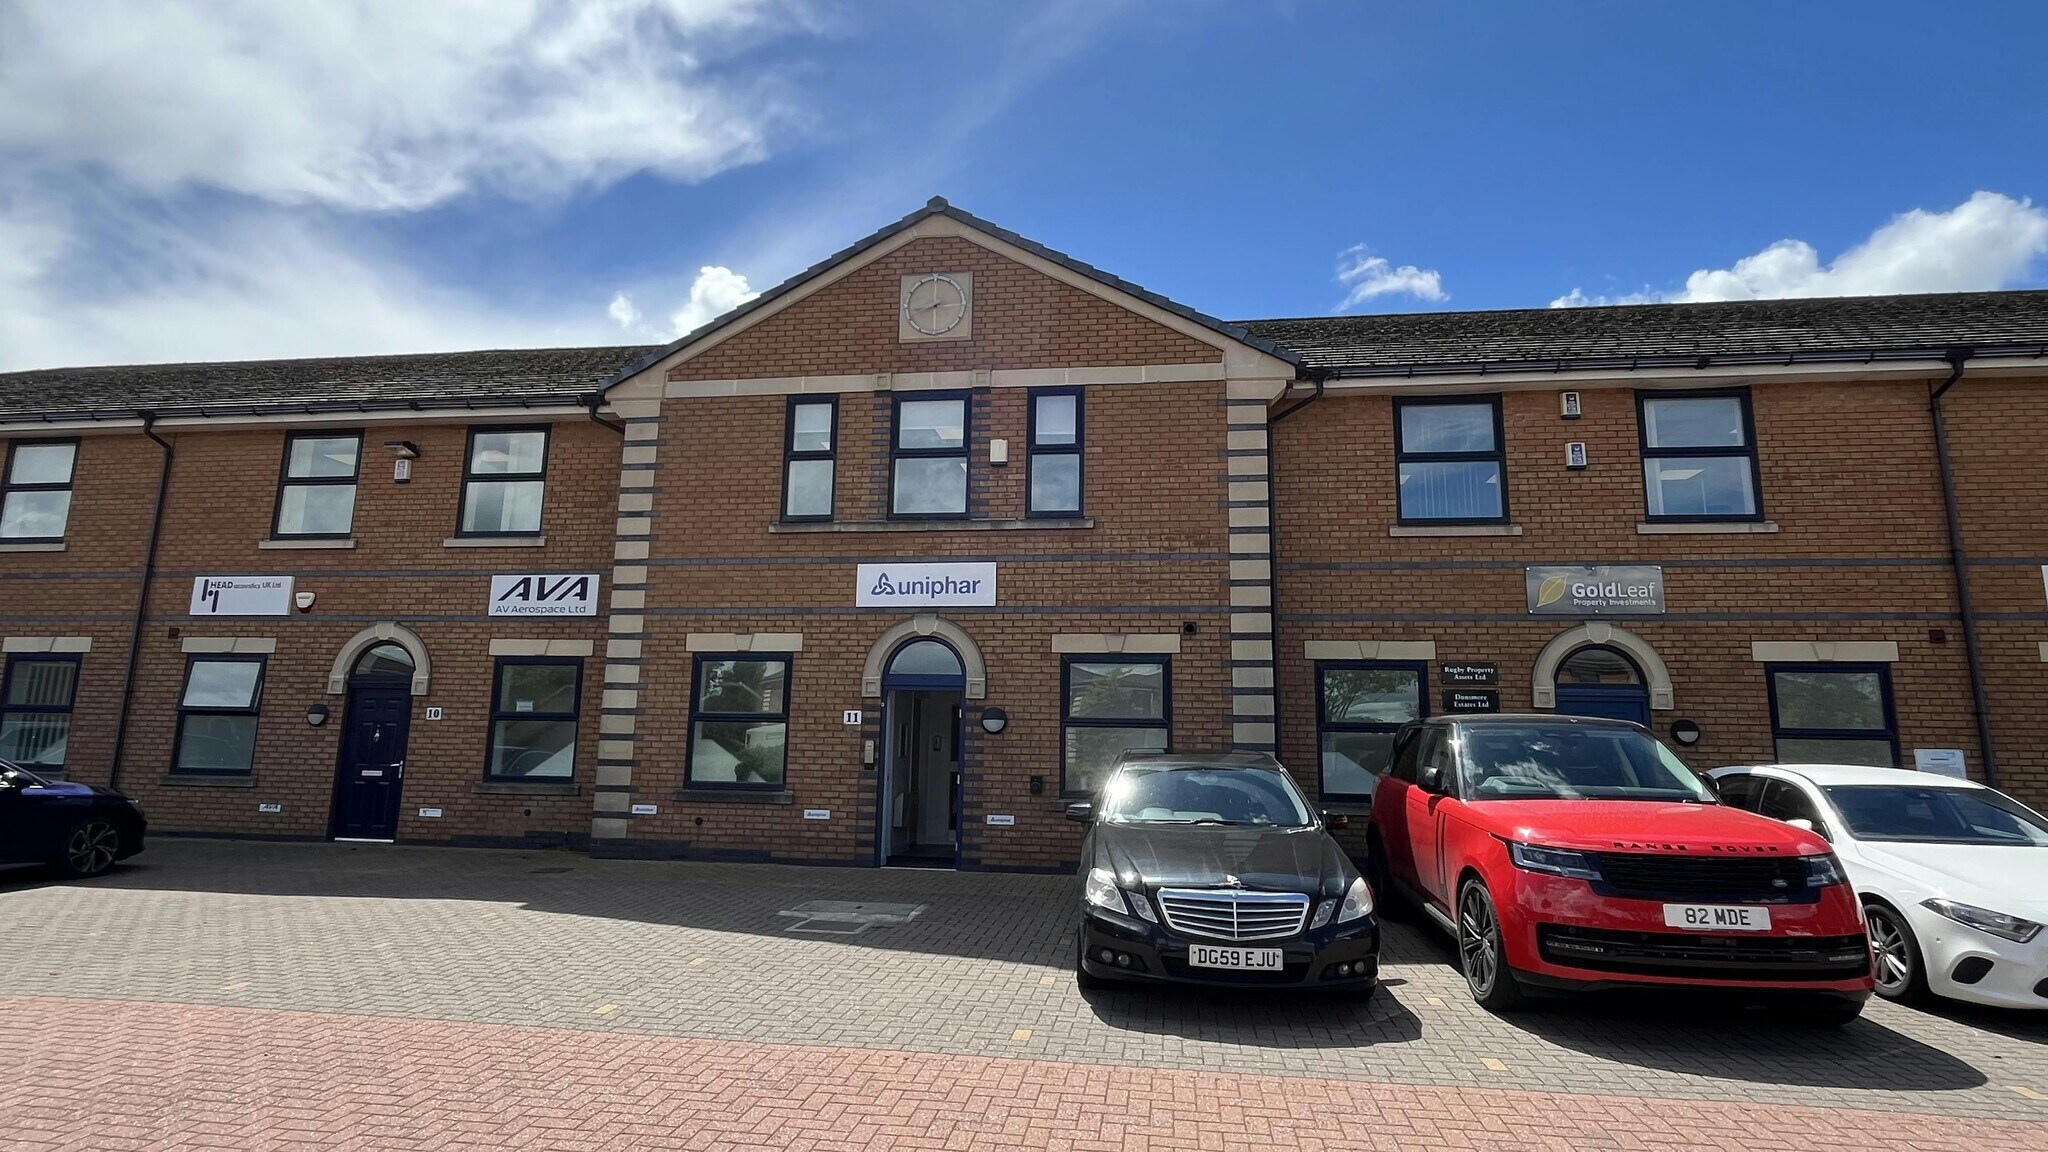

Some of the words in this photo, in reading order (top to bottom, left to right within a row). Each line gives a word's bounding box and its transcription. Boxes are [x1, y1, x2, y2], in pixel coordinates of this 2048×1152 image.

[210, 581, 233, 589] HEAD
[497, 577, 589, 601] AVA
[898, 576, 981, 599] uniphar
[1571, 582, 1656, 598] GoldLeaf
[1573, 599, 1606, 607] Property
[495, 605, 510, 613] AV
[511, 605, 566, 615] Aerospace
[568, 605, 586, 613] Ltd
[1444, 666, 1465, 674] Rugby
[1467, 666, 1495, 674] Property
[428, 709, 440, 718] 10
[847, 712, 858, 722] 11
[1614, 842, 1687, 850] RANGE
[1685, 908, 1709, 924] 82
[1715, 909, 1751, 925] MDE
[1198, 948, 1240, 966] DG59
[1245, 951, 1276, 967] EJU
